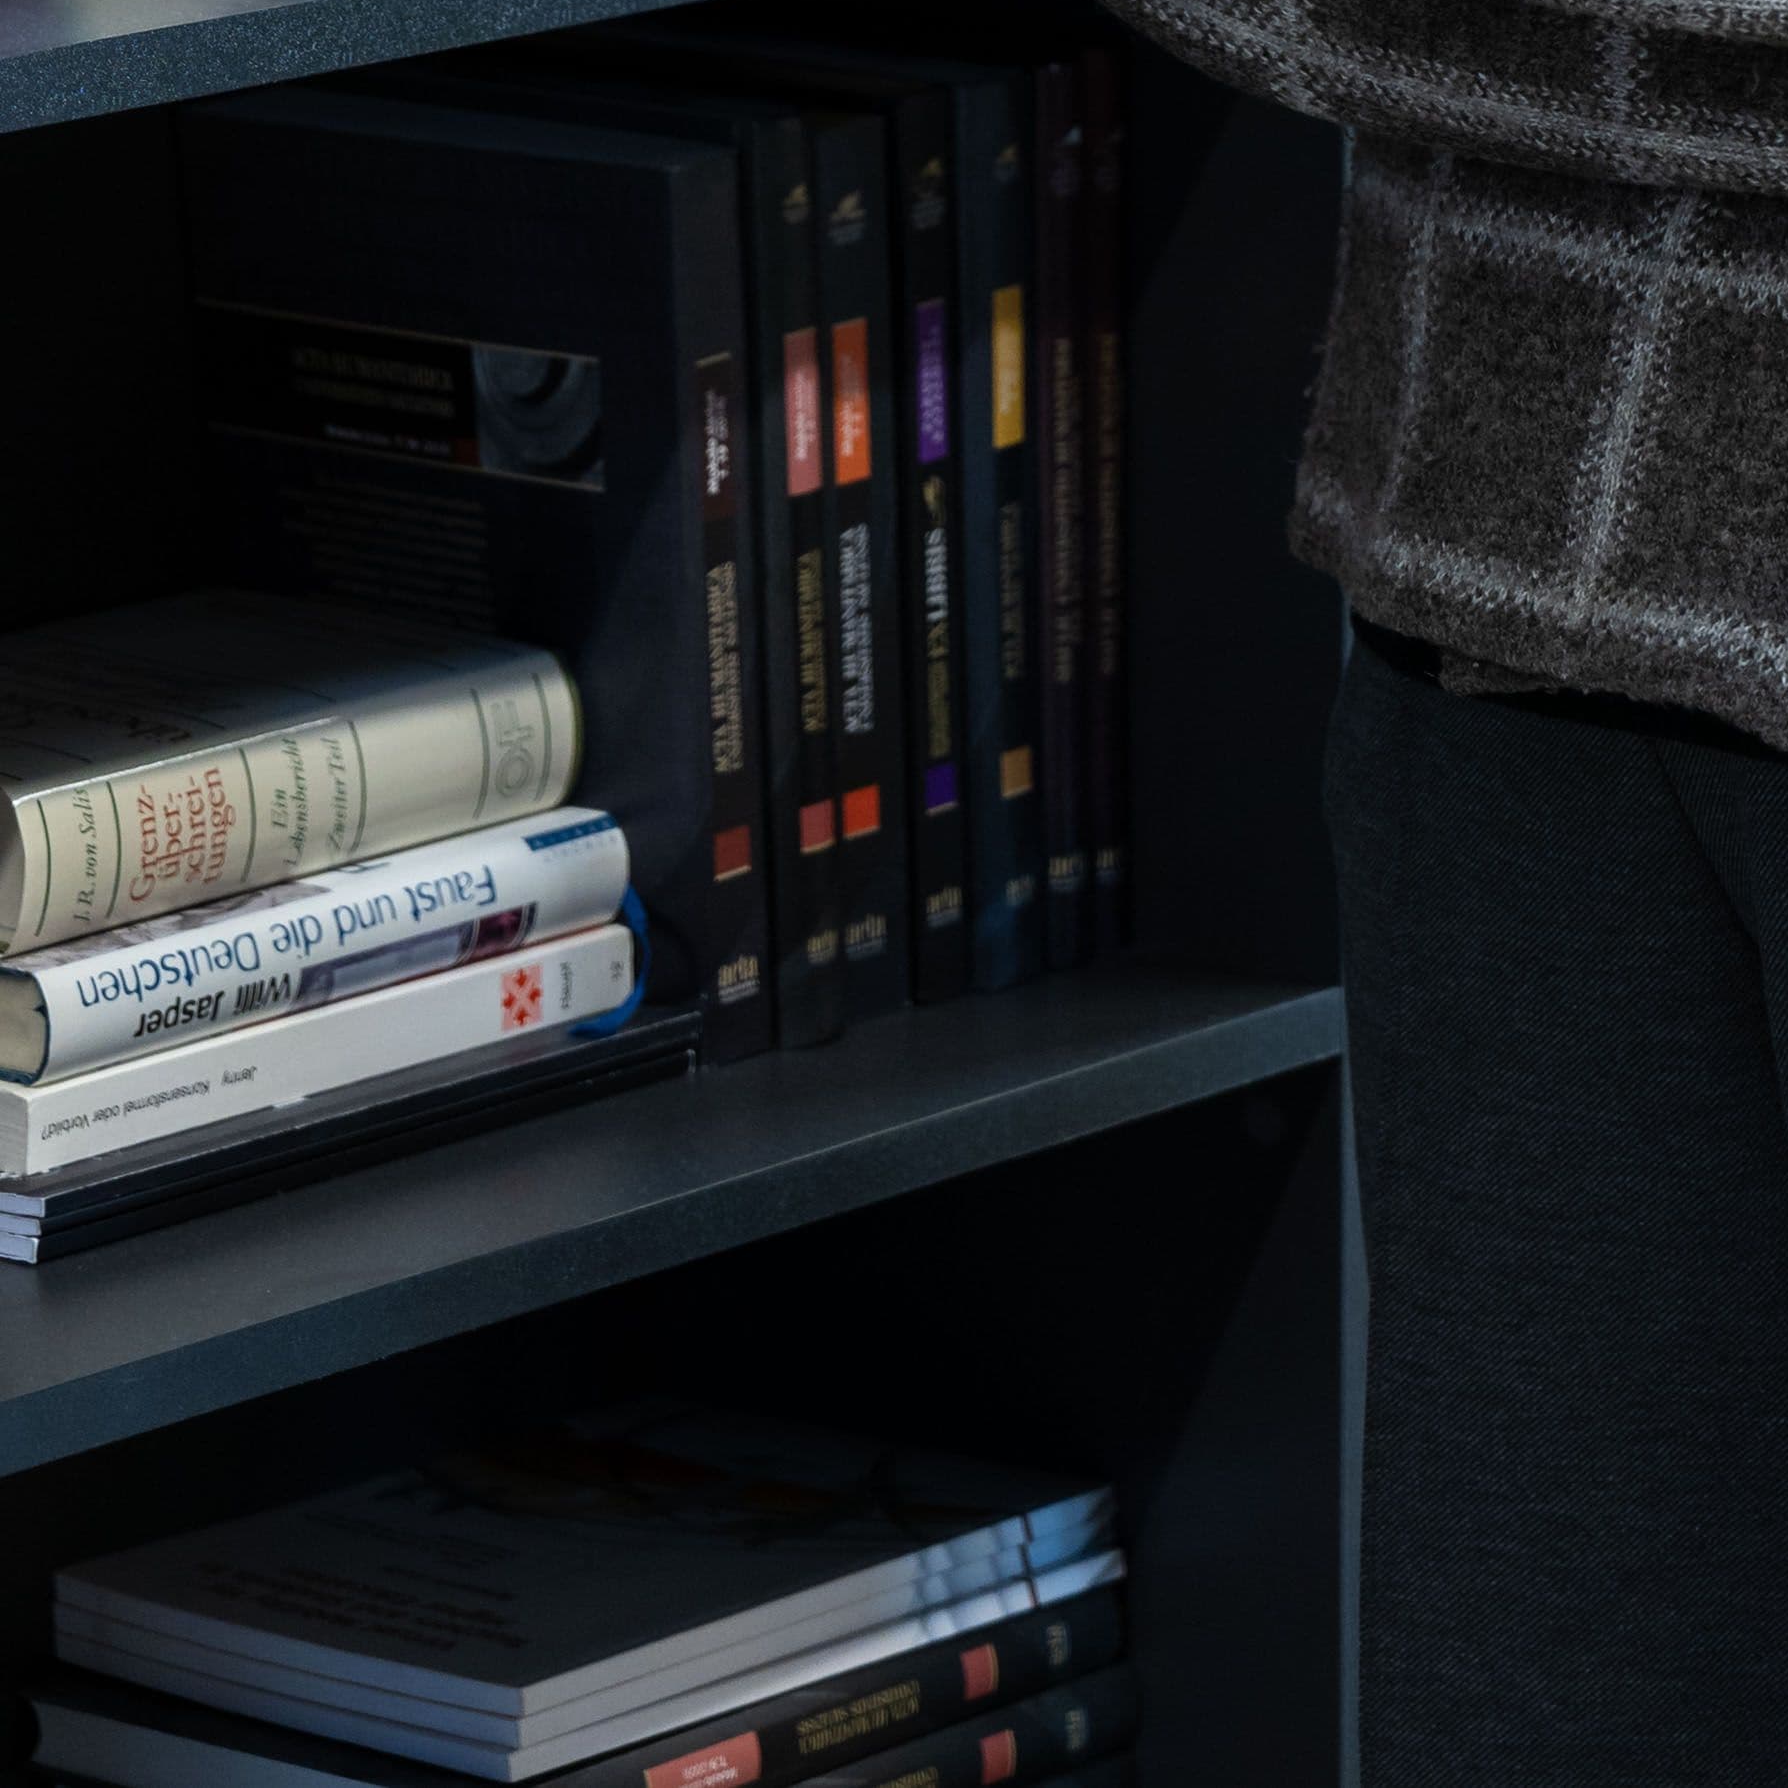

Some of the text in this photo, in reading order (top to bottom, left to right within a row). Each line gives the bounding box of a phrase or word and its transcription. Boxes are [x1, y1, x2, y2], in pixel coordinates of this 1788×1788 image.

[72, 787, 97, 880] von Salis
[129, 784, 159, 903] Grenz-
[202, 766, 237, 885] tungen
[76, 864, 498, 1008] Faust und die Deutschen
[133, 972, 292, 1038] Willi Jasper
